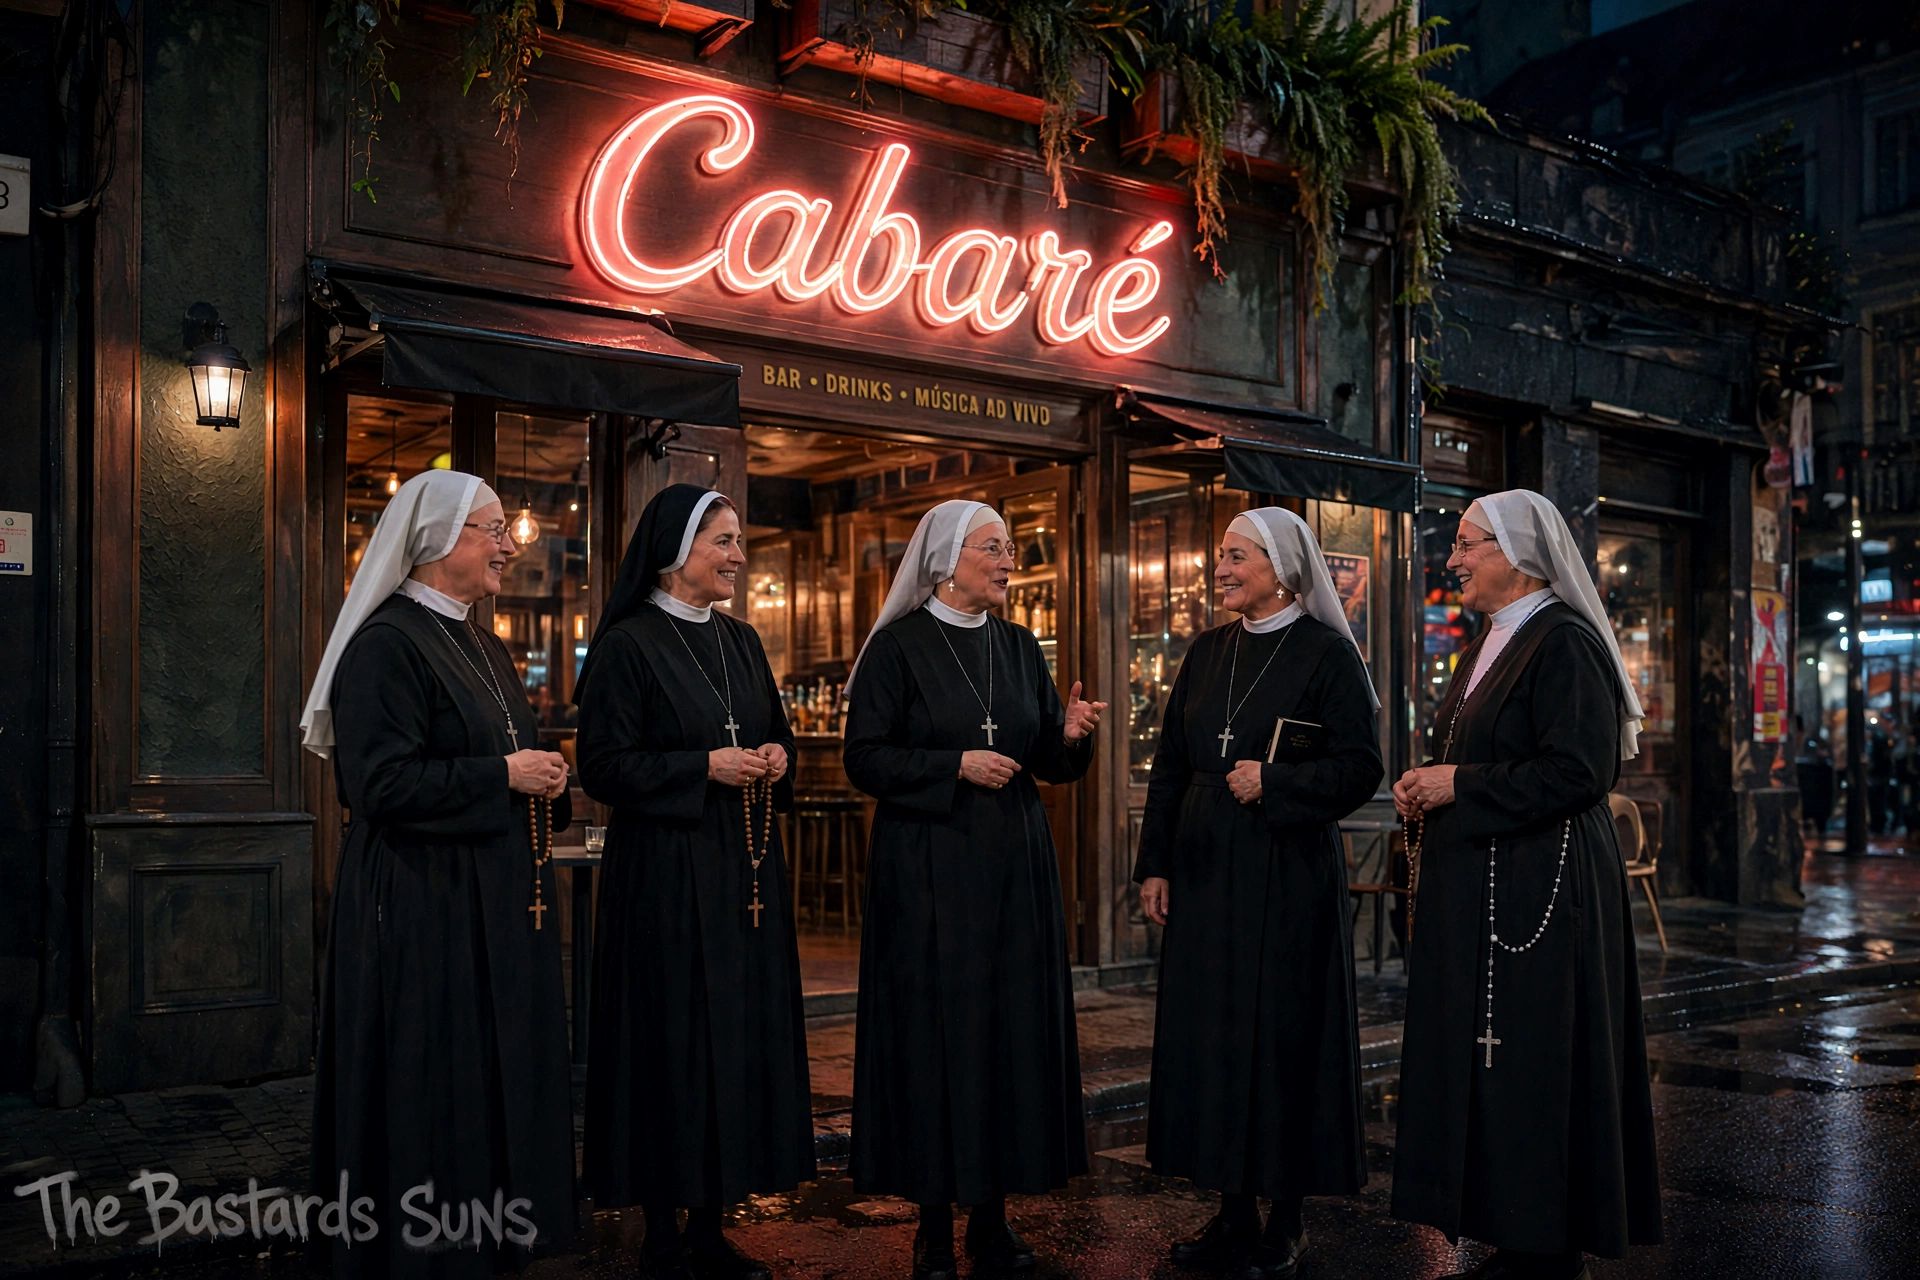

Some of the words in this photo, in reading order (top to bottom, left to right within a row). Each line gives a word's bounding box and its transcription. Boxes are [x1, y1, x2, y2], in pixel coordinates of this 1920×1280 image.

[580, 94, 1174, 355] Cabaré
[763, 364, 801, 389] BAR
[826, 373, 893, 402] DRINKS
[915, 384, 979, 416] MÚSICA
